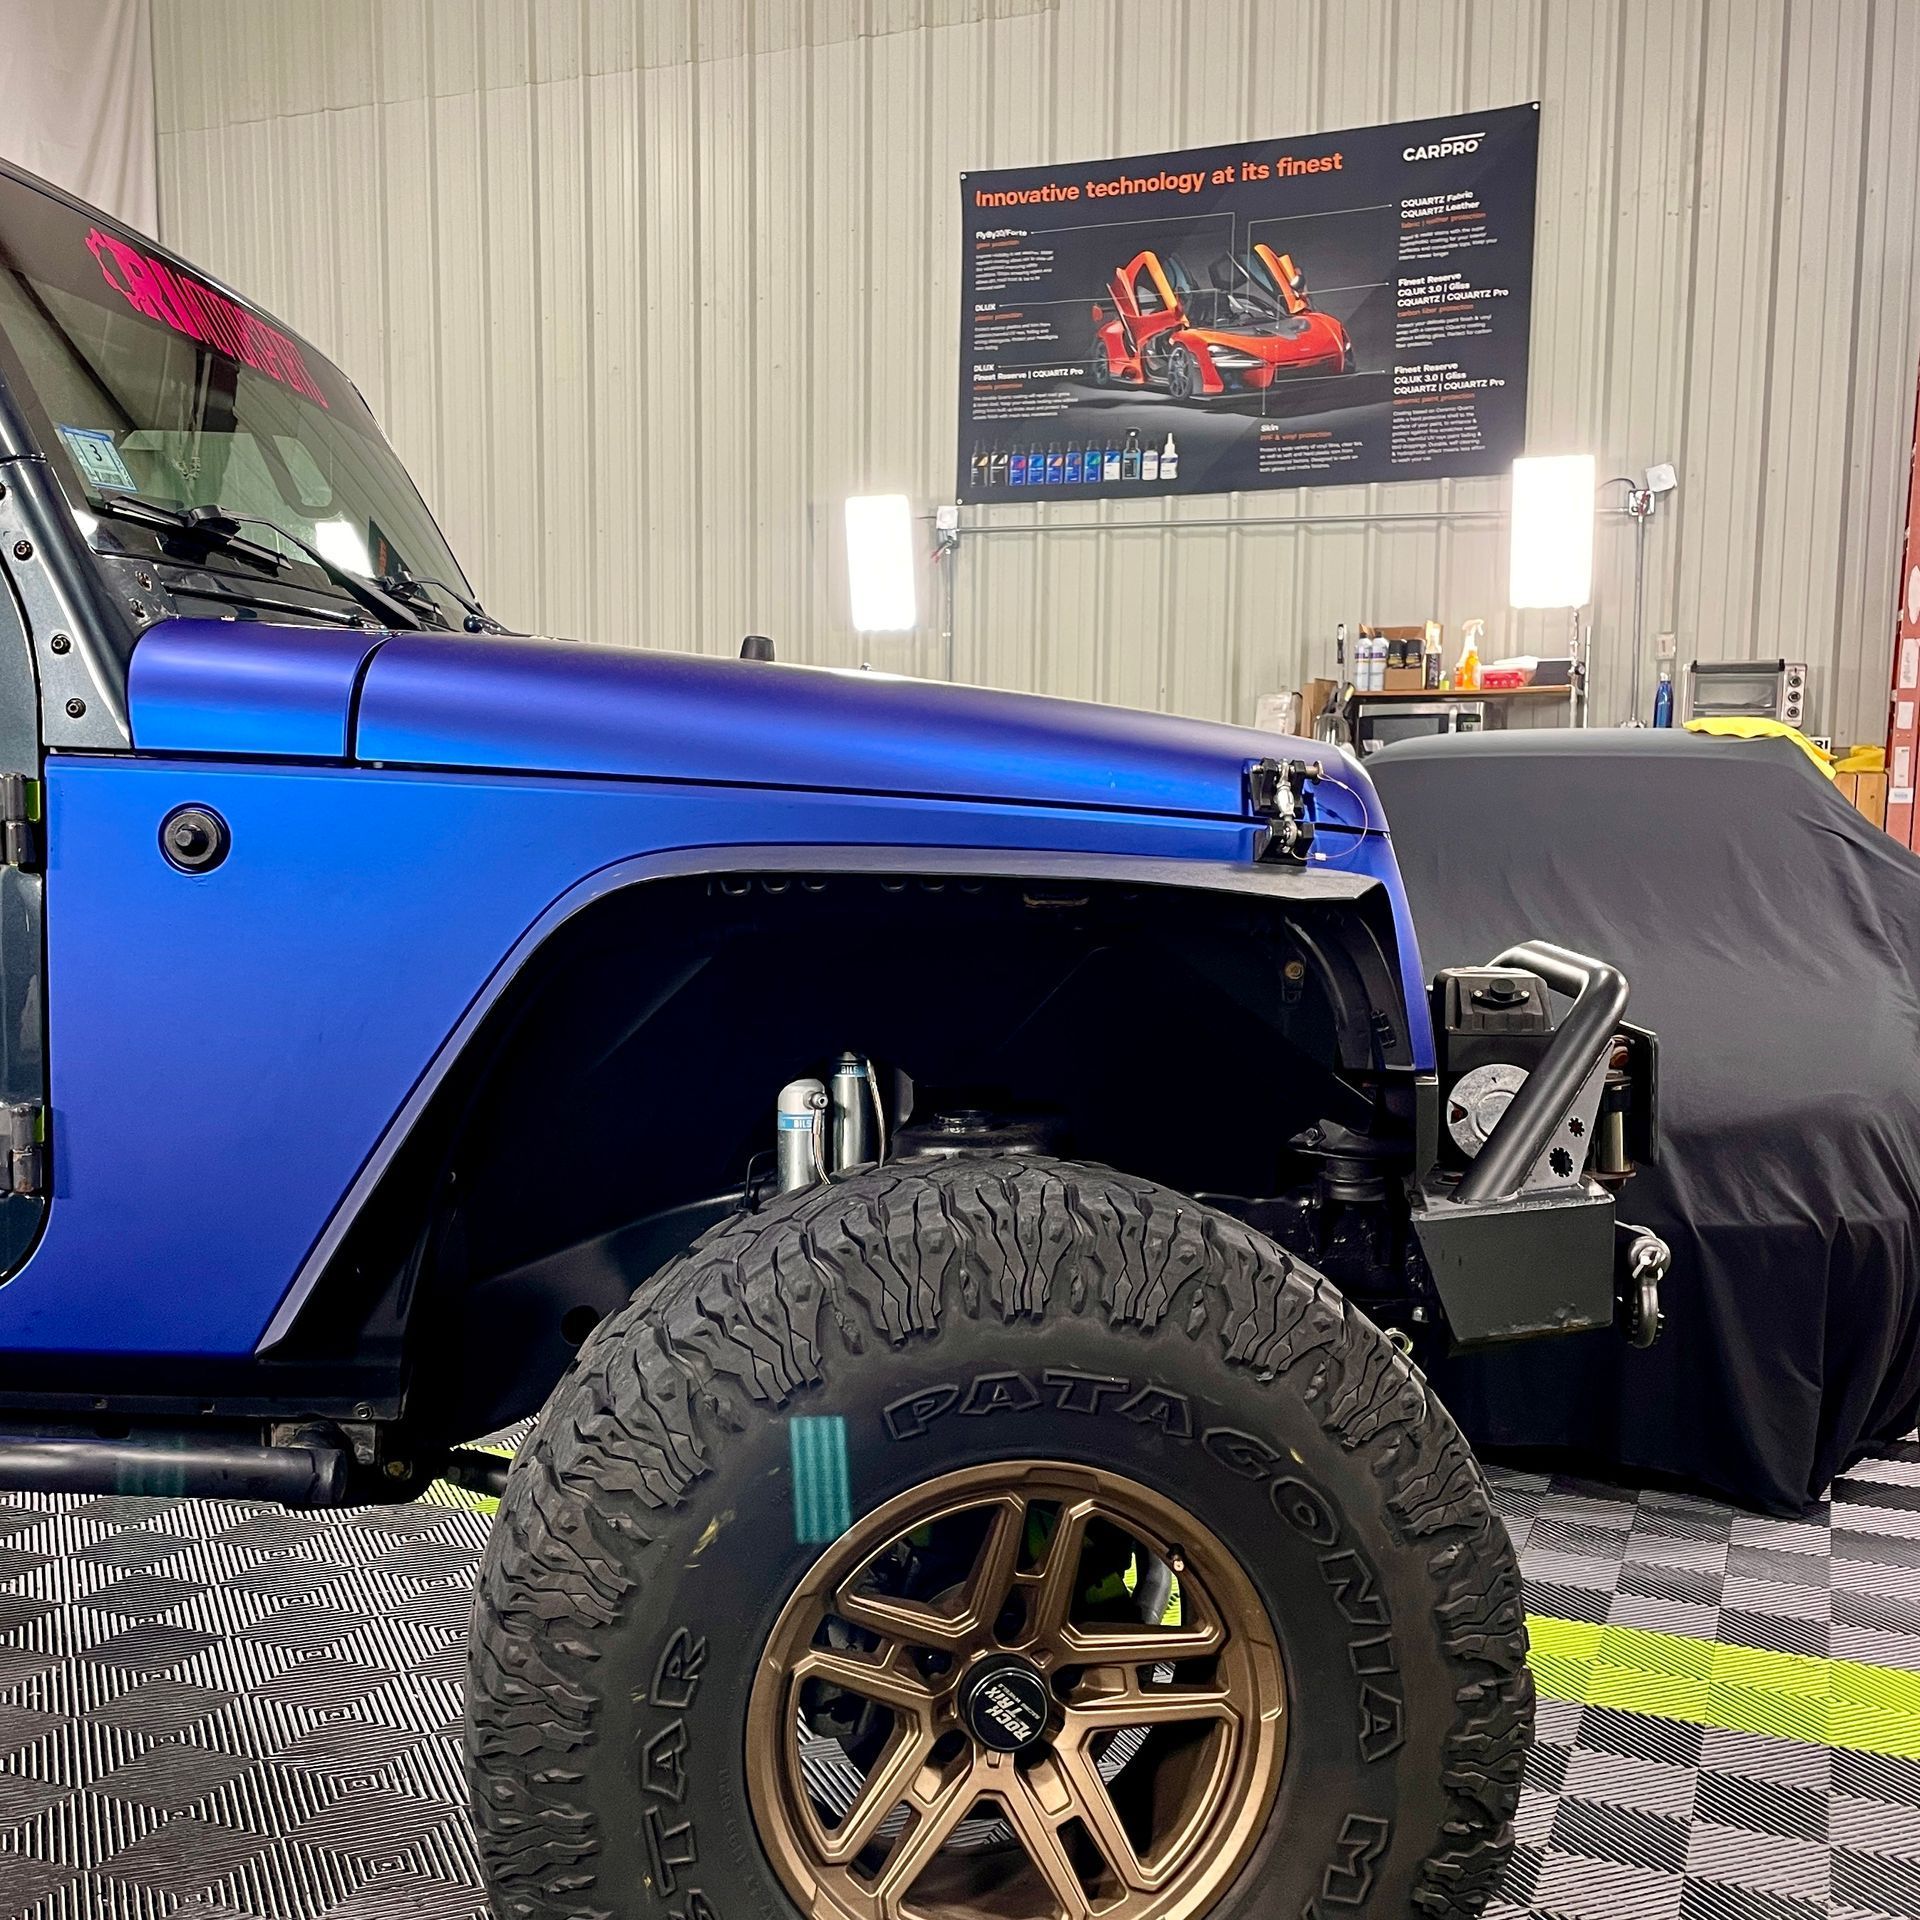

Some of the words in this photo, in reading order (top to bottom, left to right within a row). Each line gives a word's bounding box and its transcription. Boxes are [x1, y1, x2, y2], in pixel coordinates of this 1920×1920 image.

[1403, 140, 1479, 161] CARPRO
[976, 184, 1079, 207] Innovative
[1086, 171, 1205, 198] technology
[1211, 166, 1235, 184] at
[1242, 162, 1270, 181] its
[1276, 153, 1342, 177] finest
[1401, 195, 1445, 208] CQUARTZ
[1447, 191, 1473, 202] Fabric
[1401, 206, 1444, 218] CQUARTZ
[1446, 202, 1480, 211] Leather
[1398, 278, 1425, 286] Finest
[1427, 274, 1461, 284] Reserve
[1397, 297, 1440, 307] CQUARTZ
[1447, 290, 1491, 301] CQUARTZ
[1493, 289, 1509, 297] Pro
[975, 304, 996, 312] DLUX
[974, 364, 994, 372] DLUX
[1032, 369, 1068, 378] CQUARTZ
[1394, 366, 1421, 374] Finest
[1423, 363, 1458, 372] Reserve
[1393, 384, 1437, 394] CQUARTZ
[1443, 380, 1488, 390] CQUARTZ
[89, 444, 103, 461] 3
[841, 1066, 858, 1074] BILS
[794, 1120, 812, 1128] BILS
[883, 1368, 1406, 1763] PATAGONIA
[985, 1705, 1032, 1741] ROCK
[642, 1626, 718, 1920] TAR
